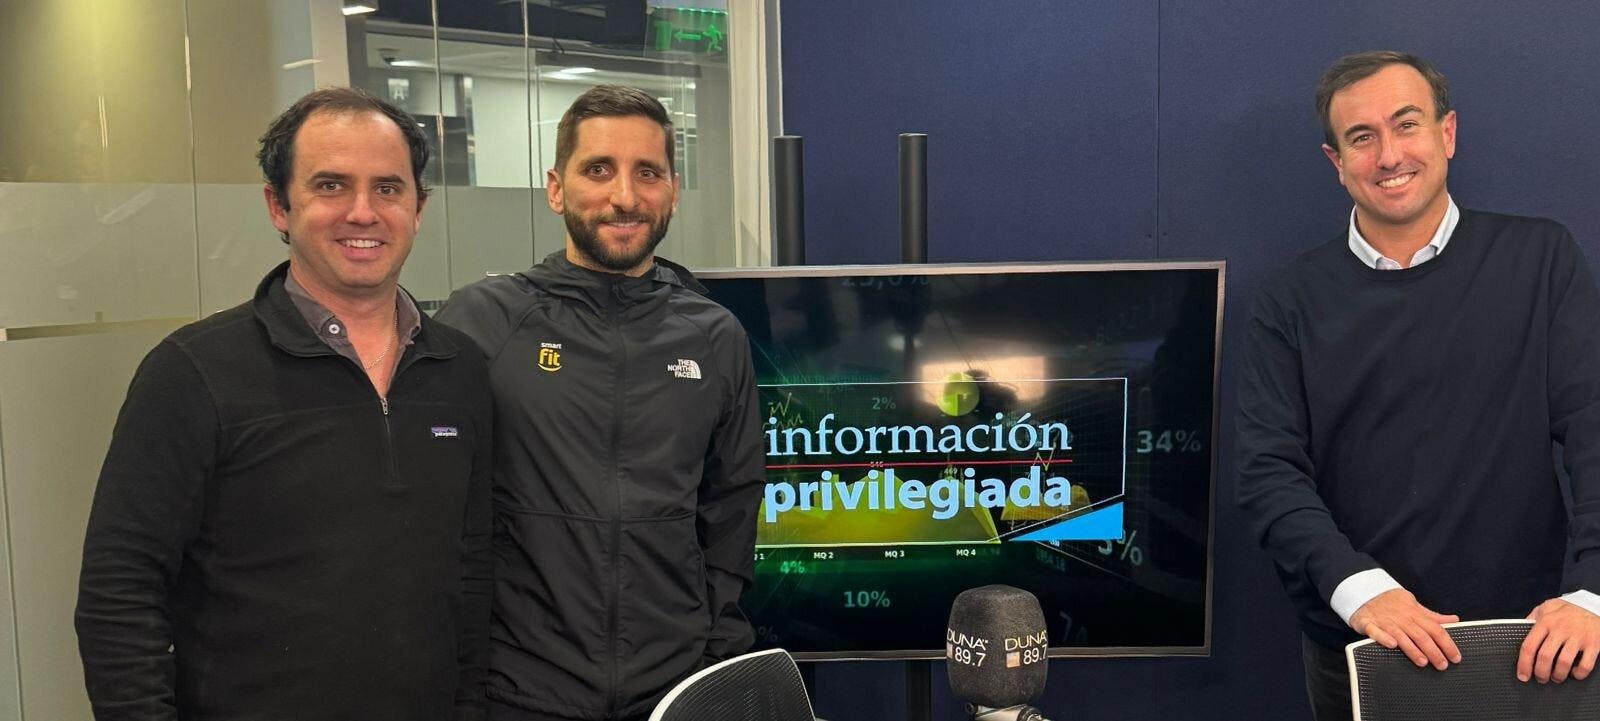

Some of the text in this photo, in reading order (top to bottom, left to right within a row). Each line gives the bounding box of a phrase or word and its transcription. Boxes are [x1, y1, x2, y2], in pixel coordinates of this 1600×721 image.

[539, 348, 560, 367] fit
[667, 364, 690, 372] NORTH
[674, 371, 691, 379] FACE
[872, 397, 897, 410] 2%
[765, 412, 1072, 456] información
[1136, 429, 1201, 454] 34%
[764, 466, 1072, 523] privilegiada
[813, 551, 834, 560] MQ 2
[884, 550, 905, 559] MQ 3
[955, 548, 970, 558] MQ
[970, 548, 976, 556] 4
[780, 561, 805, 574] 4%
[844, 590, 890, 609] 10%
[954, 646, 986, 667] 89.7
[1023, 644, 1047, 665] 89.7
